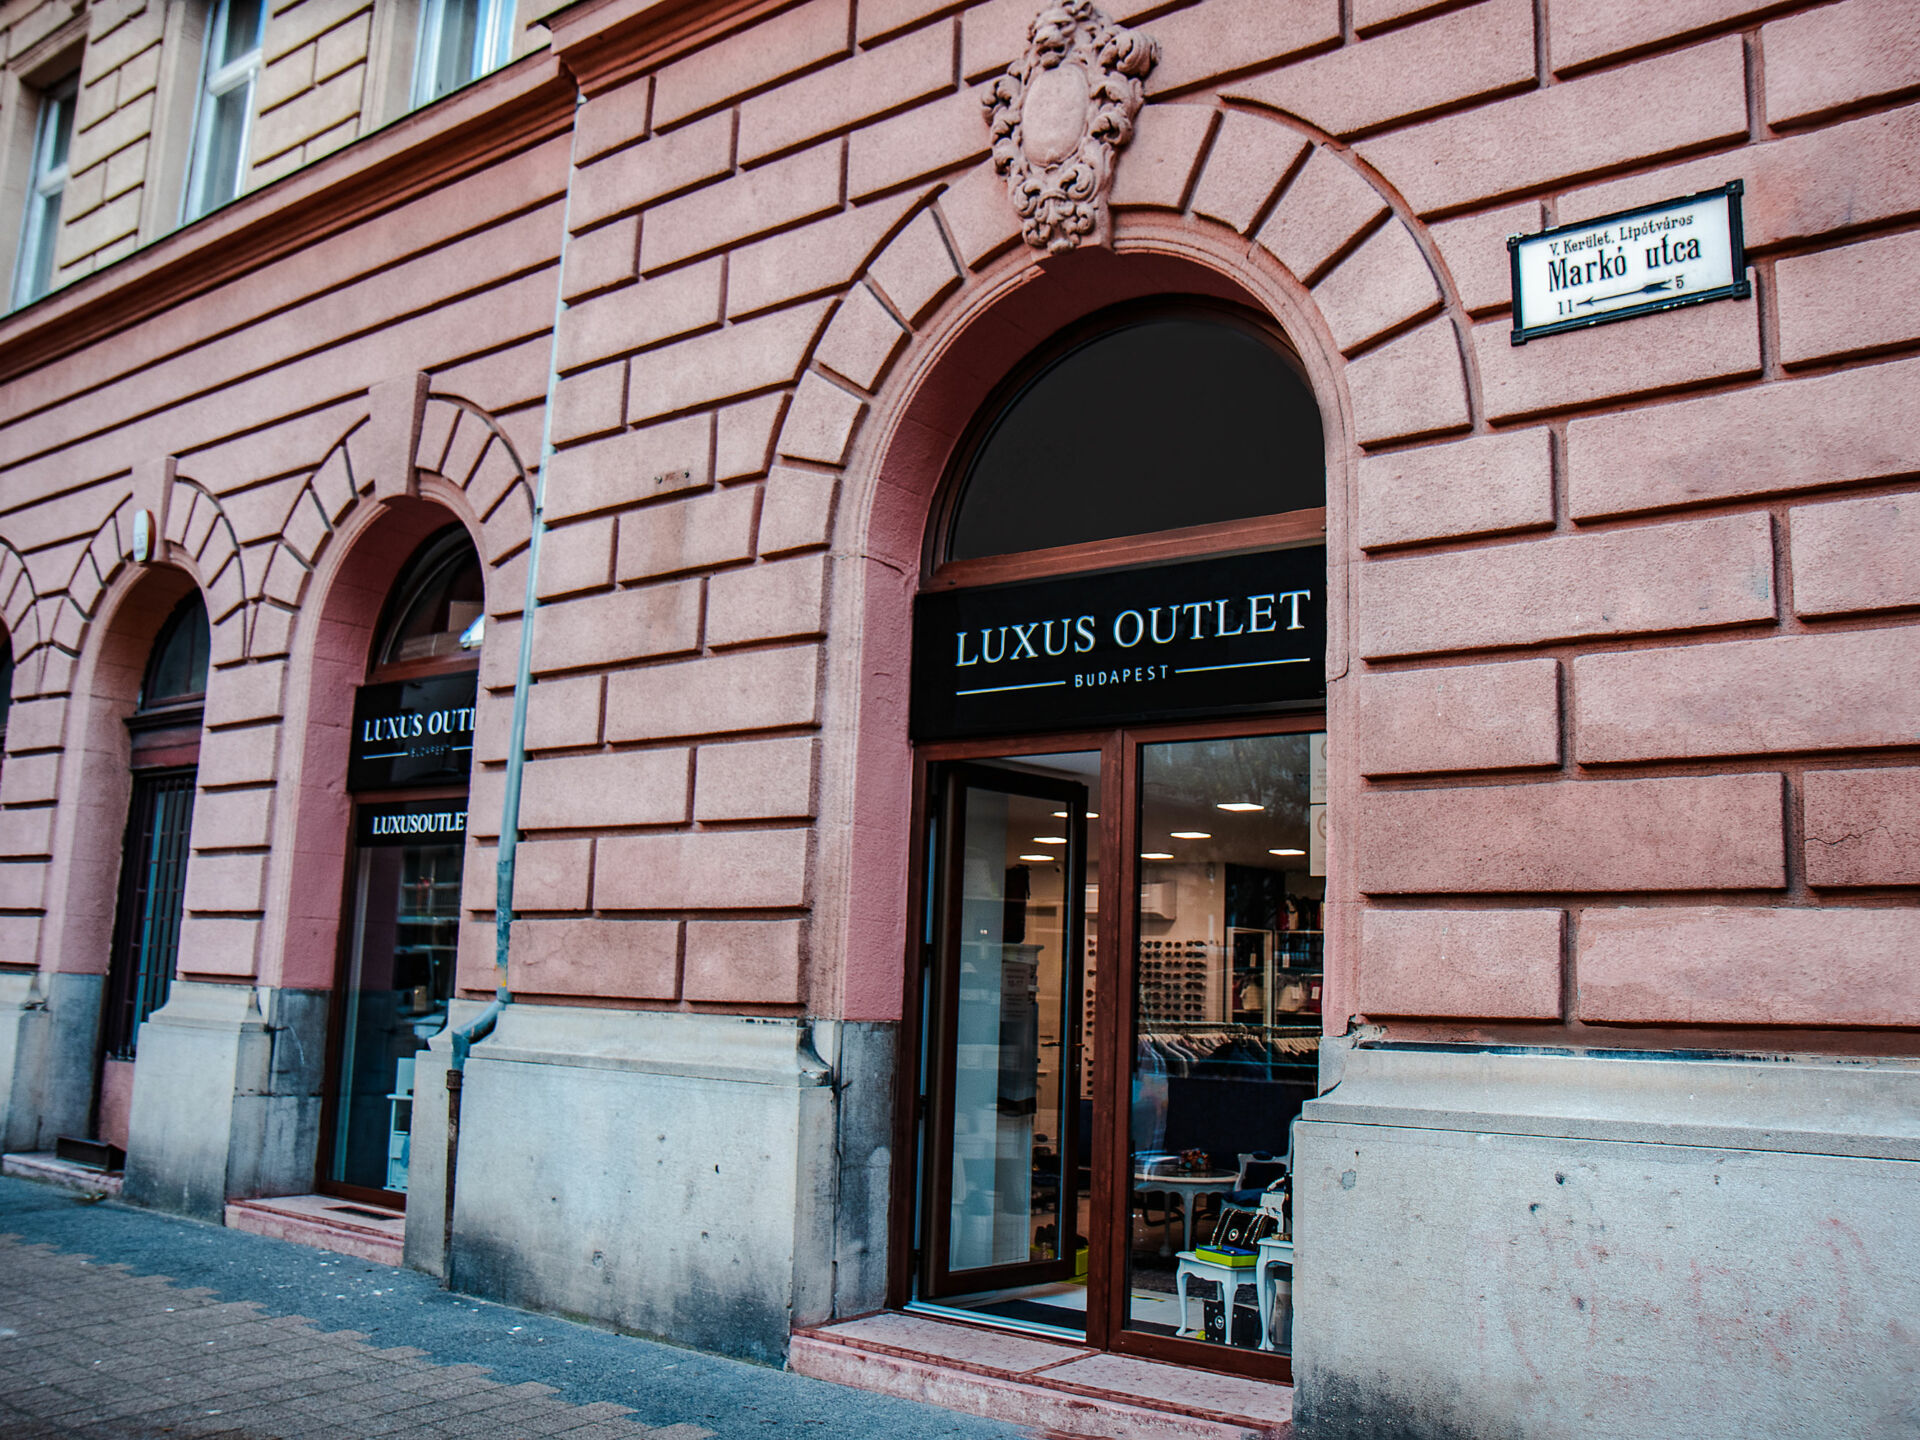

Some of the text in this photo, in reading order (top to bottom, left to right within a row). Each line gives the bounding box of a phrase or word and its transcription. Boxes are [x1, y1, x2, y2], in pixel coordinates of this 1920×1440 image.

[1549, 243, 1560, 256] V.
[1619, 214, 1694, 242] Lipótváros
[1547, 234, 1701, 293] Markó utca
[1557, 275, 1685, 316] 11 5
[955, 589, 1311, 667] LUXUS OUTLET
[1074, 664, 1169, 688] BUDAPEST
[364, 713, 423, 742] LUXUS
[373, 811, 468, 835] LUXUSOUTLE
